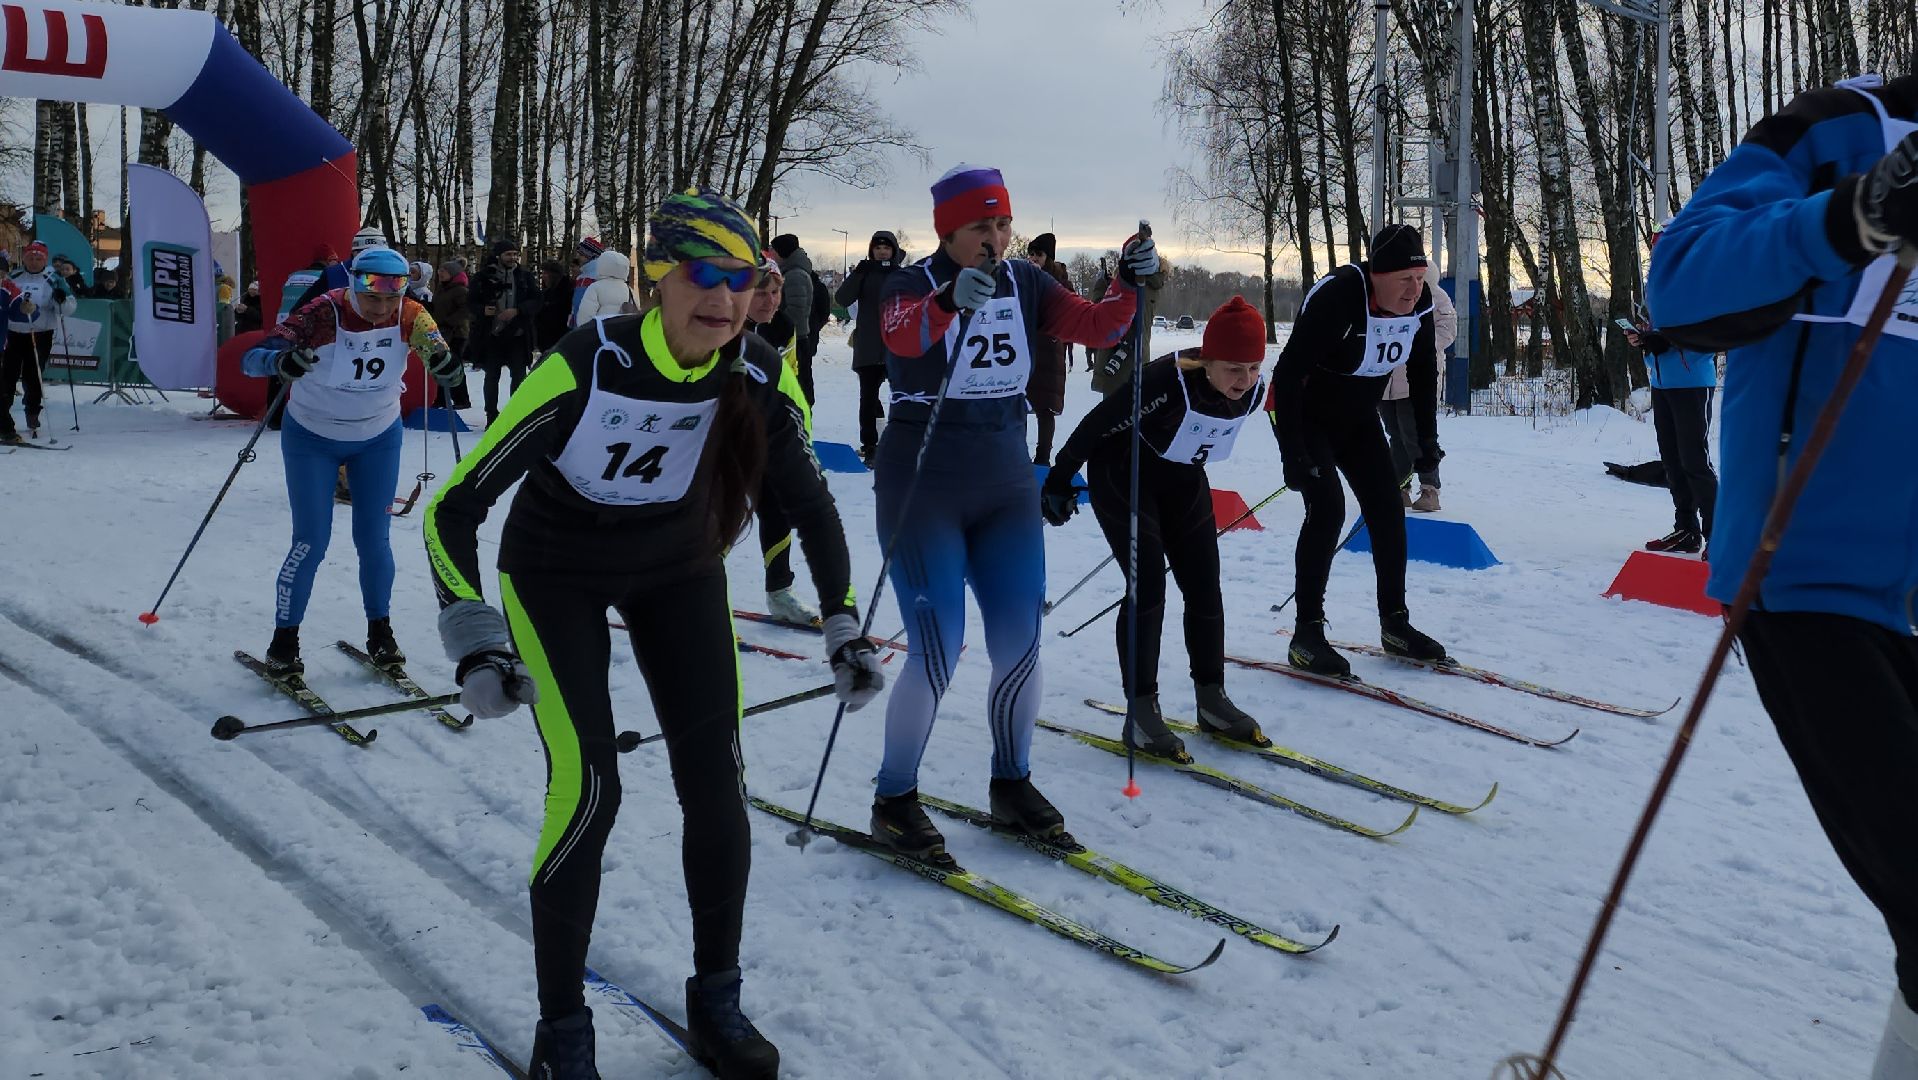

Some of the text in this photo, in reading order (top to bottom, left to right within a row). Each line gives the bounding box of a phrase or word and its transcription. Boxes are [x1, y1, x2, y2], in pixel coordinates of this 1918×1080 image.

[154, 250, 180, 320] ПАРИ
[177, 254, 193, 322] И ПОБЕЖДАЙ
[352, 357, 386, 381] 19
[966, 333, 1017, 369] 25
[1376, 341, 1403, 364] 10
[601, 441, 670, 484] 14
[1190, 444, 1215, 465] 5
[278, 541, 311, 621] SOCHI 2014
[894, 854, 947, 883] FISCHER
